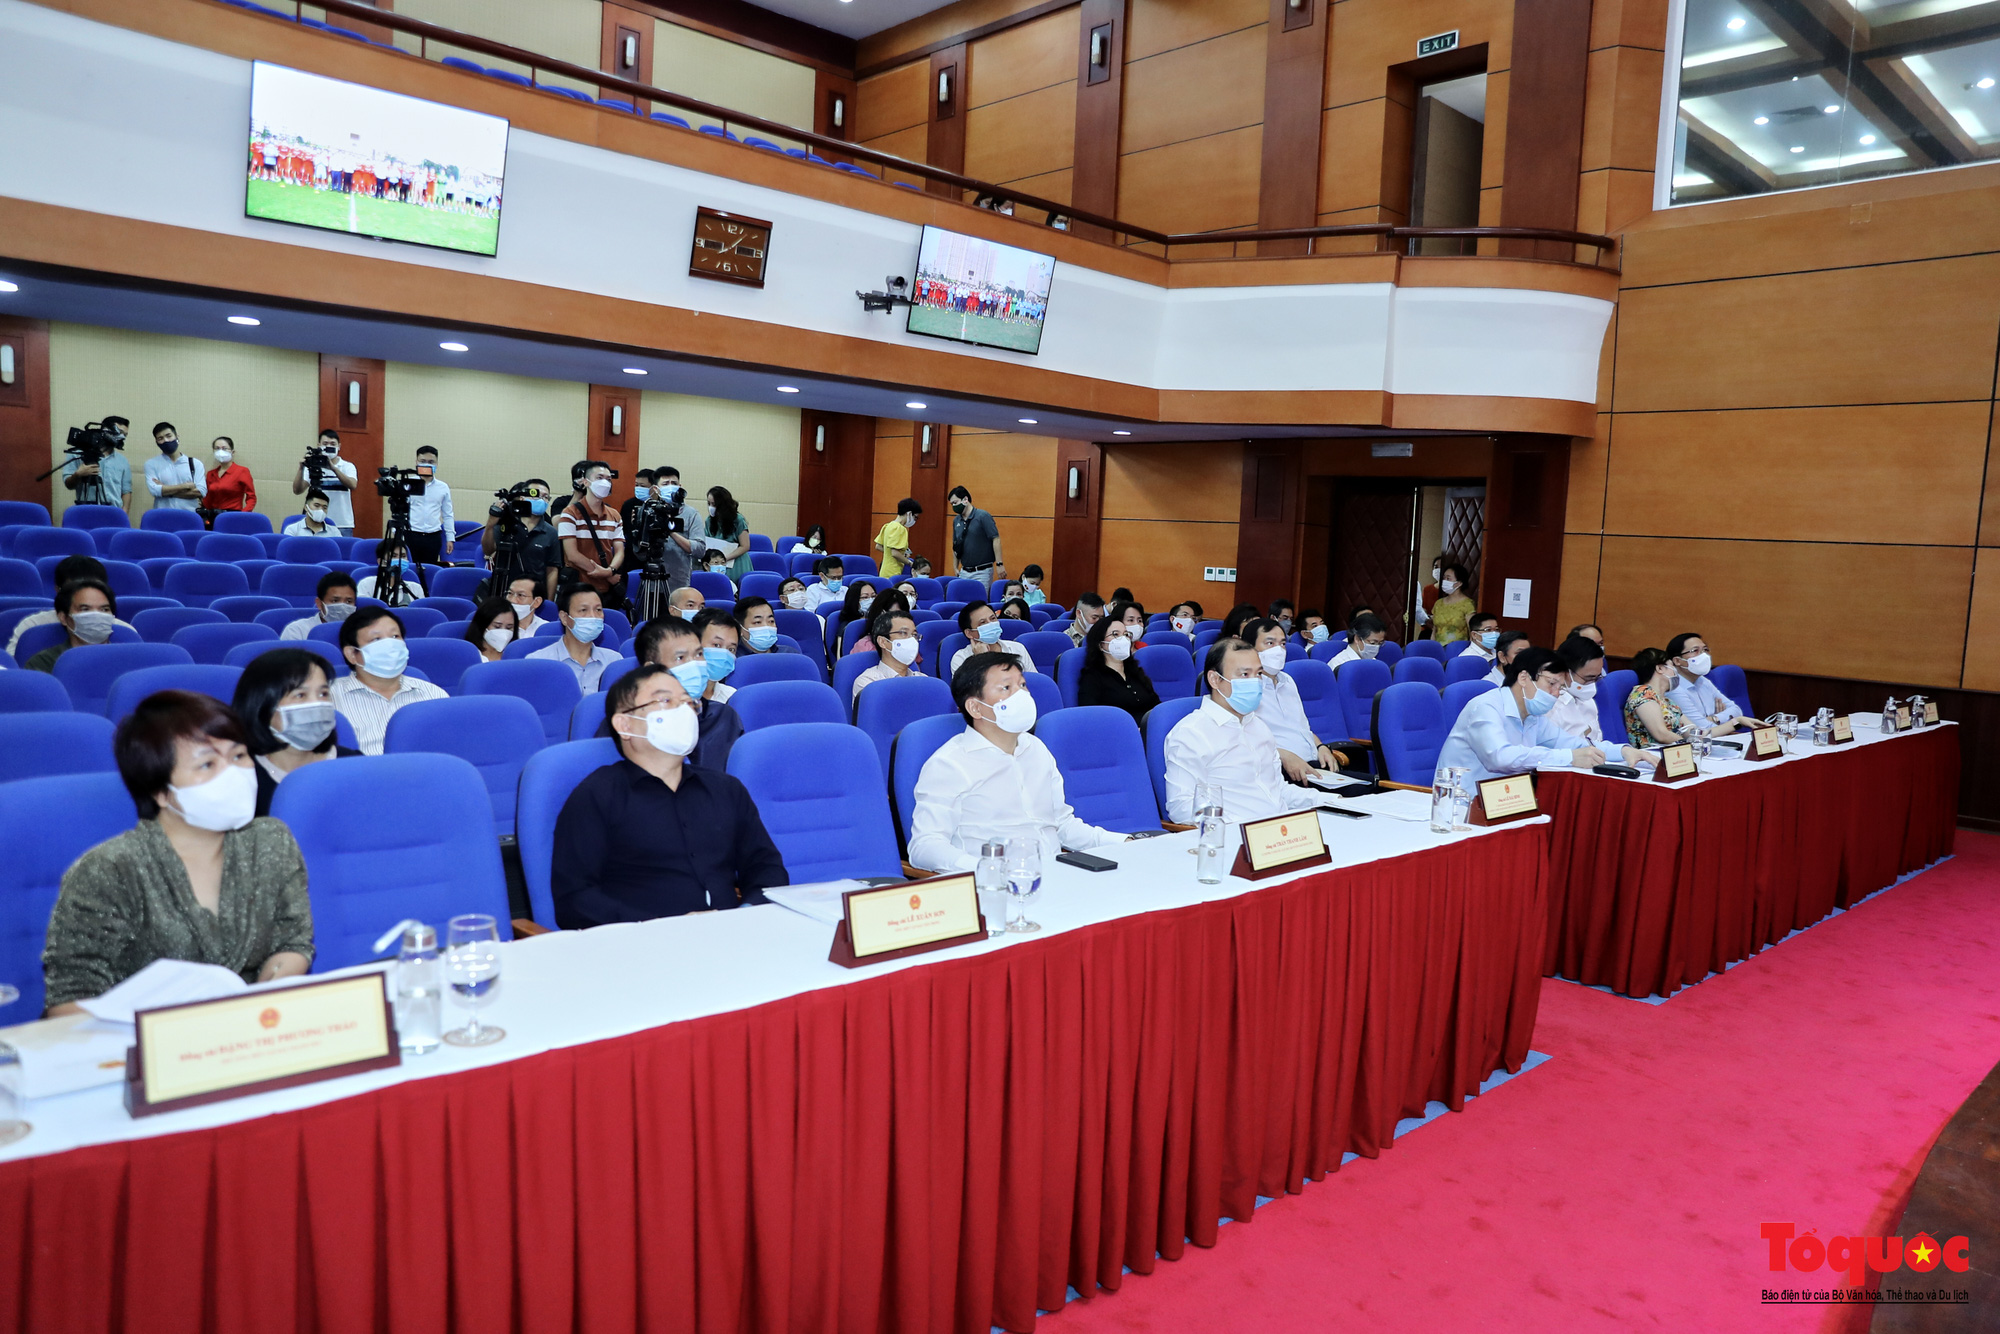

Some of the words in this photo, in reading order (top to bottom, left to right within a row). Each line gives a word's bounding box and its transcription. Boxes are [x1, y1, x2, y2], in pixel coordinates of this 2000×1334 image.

[1422, 36, 1453, 52] EXIT
[727, 224, 738, 235] 12
[695, 237, 704, 248] 9
[755, 249, 764, 259] 3
[722, 262, 731, 272] 6
